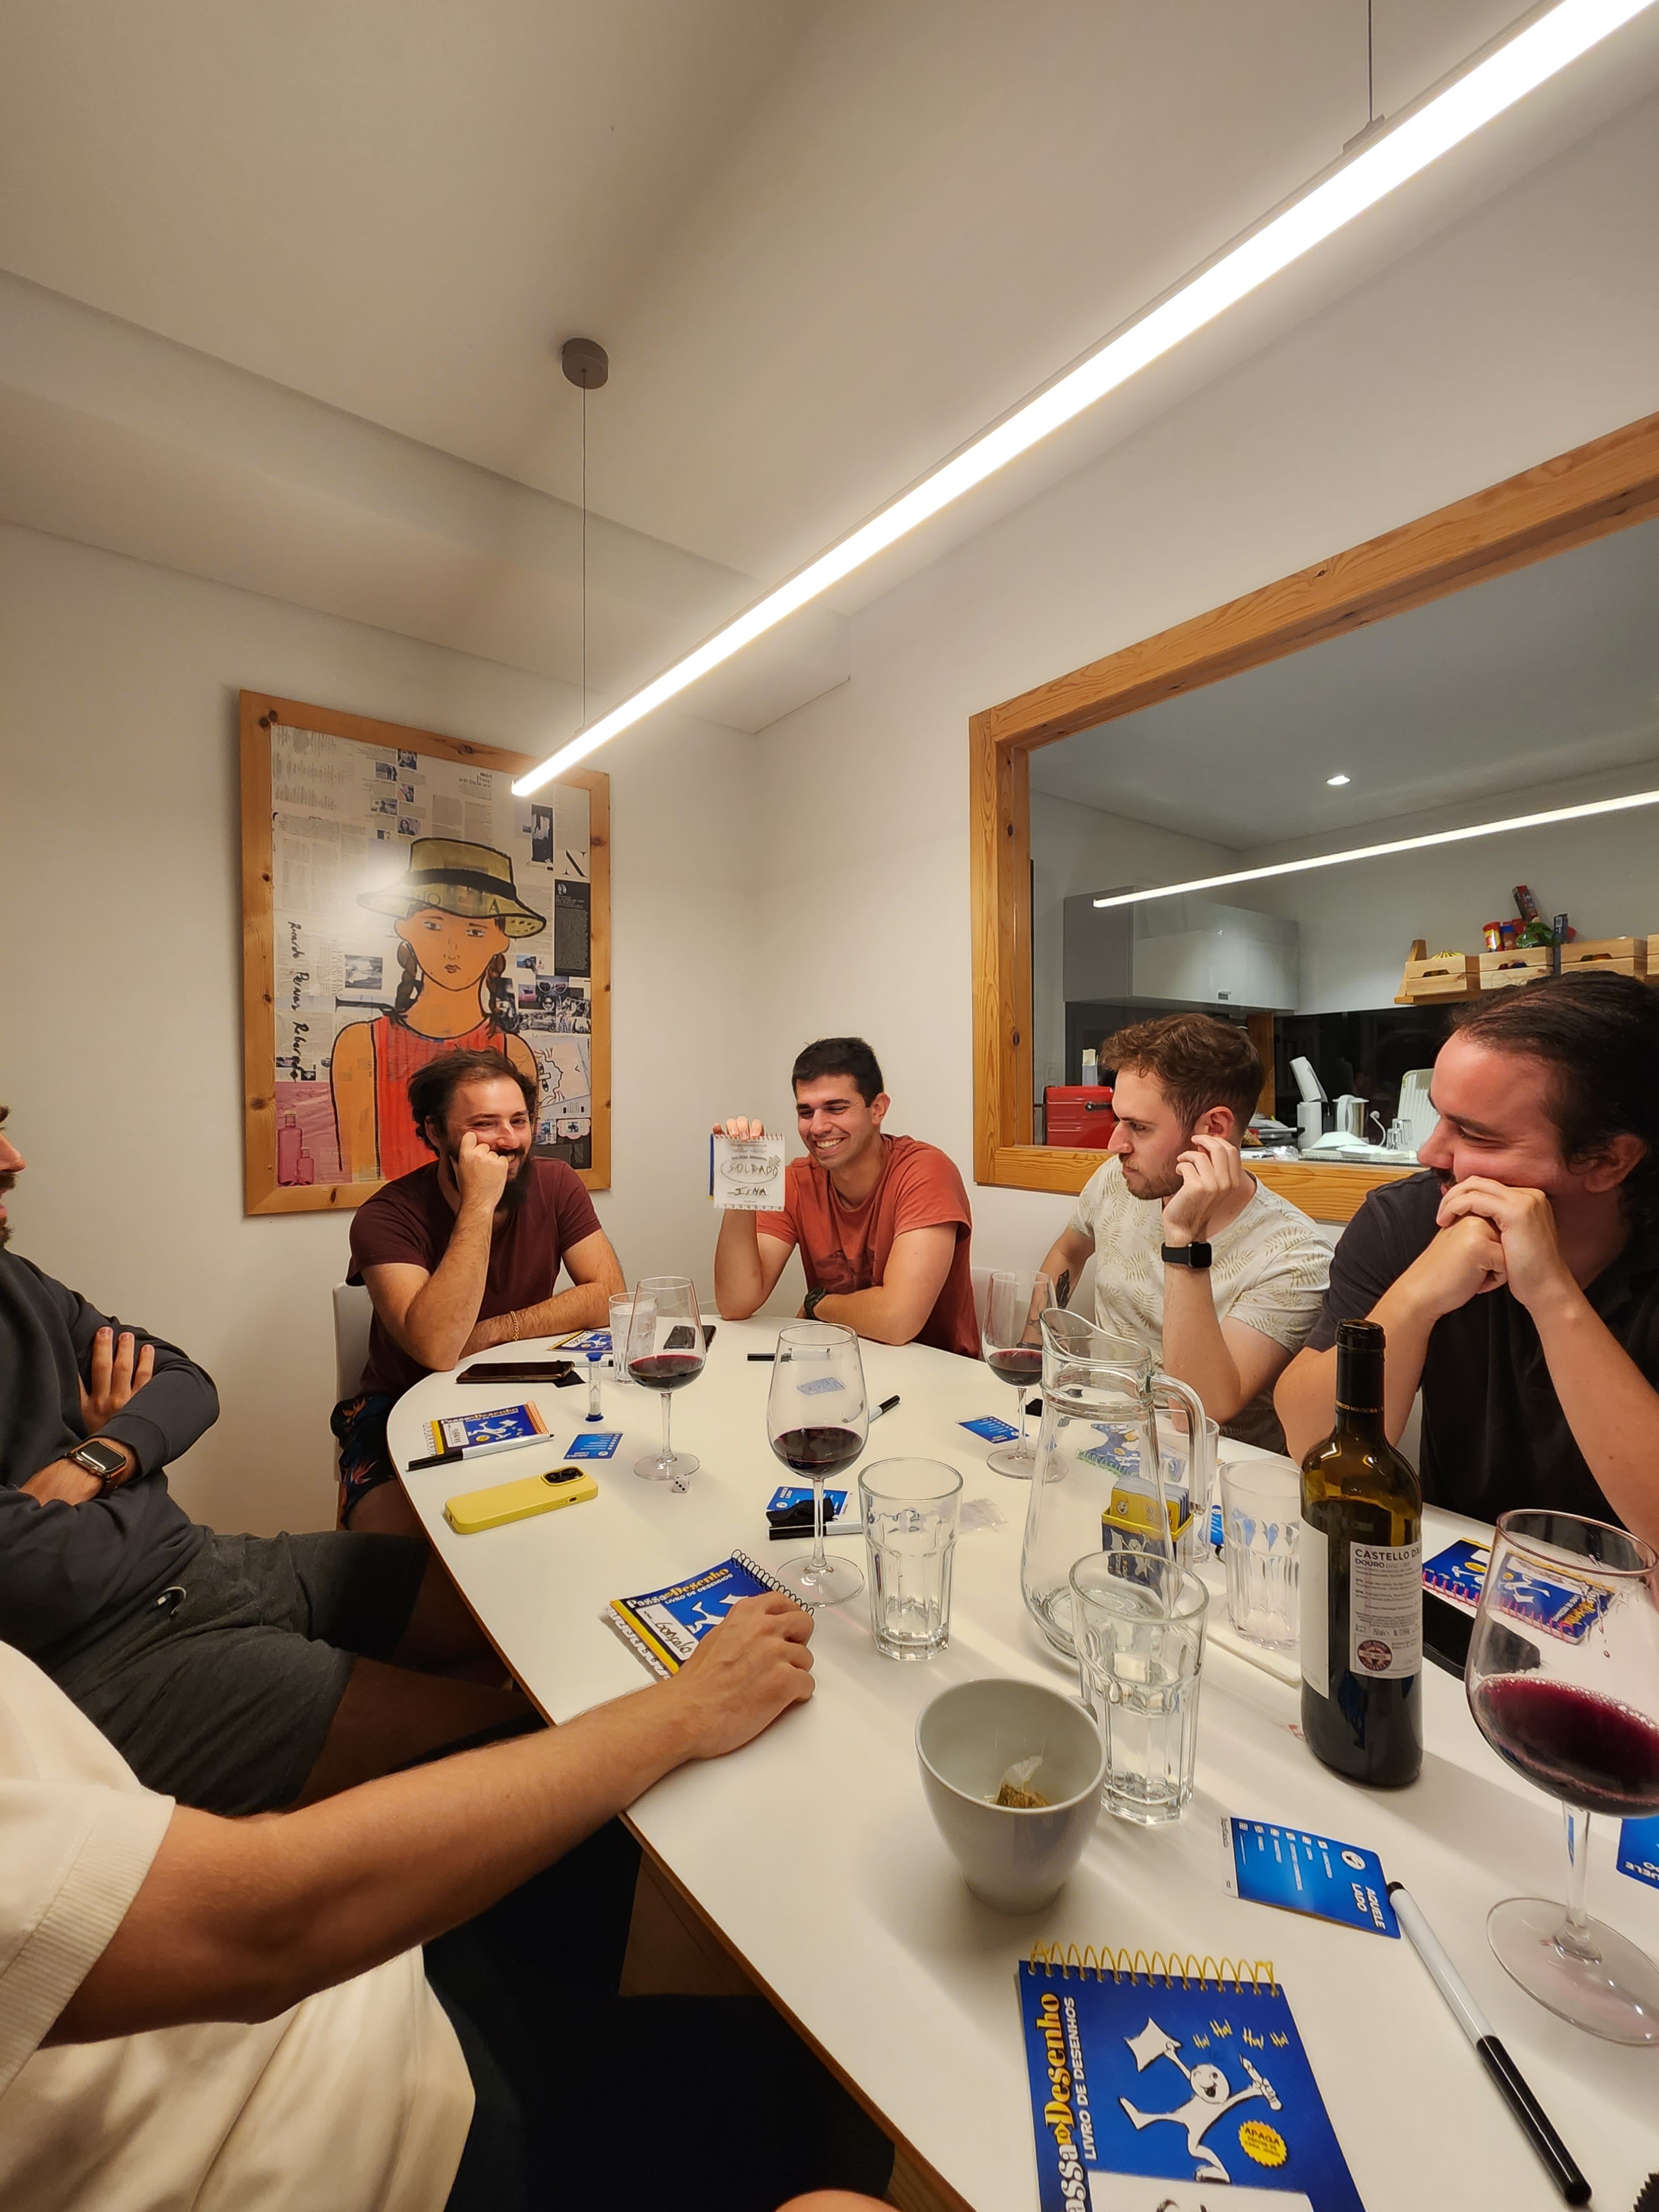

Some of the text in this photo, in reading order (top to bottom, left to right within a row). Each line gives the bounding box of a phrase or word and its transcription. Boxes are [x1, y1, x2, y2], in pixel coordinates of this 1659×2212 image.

[727, 1162, 778, 1176] SOLDADO
[1355, 1549, 1410, 1561] CASTELLO
[1355, 1558, 1385, 1568] DOURO
[665, 1594, 686, 1605] LIVRO
[698, 1573, 734, 1593] DESENHOS
[1351, 1882, 1368, 1912] LADO
[1365, 1885, 1386, 1930] AQUELE
[1036, 1992, 1076, 2127] Desenho
[1063, 1996, 1097, 2161] LIVRO DE DESENHOS
